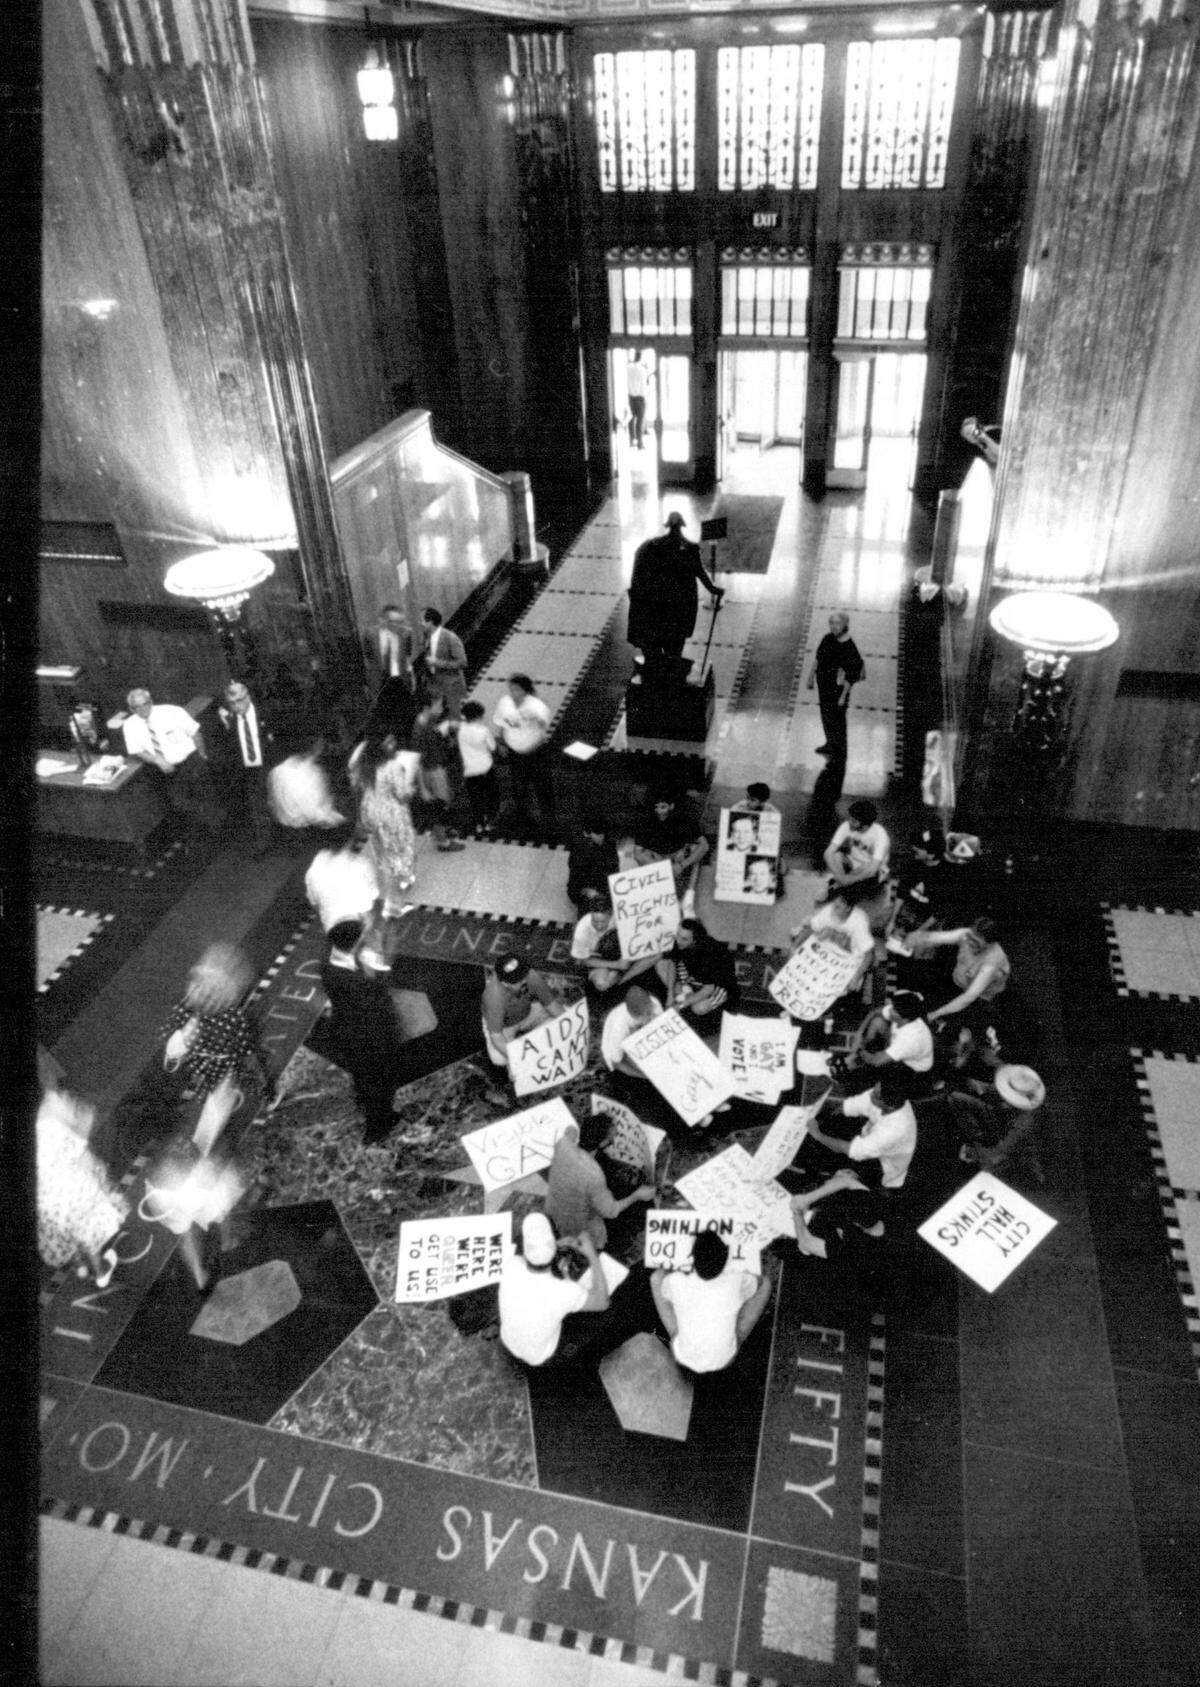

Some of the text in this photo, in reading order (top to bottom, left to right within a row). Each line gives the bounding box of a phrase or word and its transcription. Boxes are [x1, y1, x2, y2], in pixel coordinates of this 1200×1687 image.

[753, 213, 777, 227] EXIT
[613, 872, 669, 895] CIVIL
[617, 893, 677, 920] RIGHTS
[635, 912, 663, 933] FOR
[628, 931, 677, 957] GAYS
[521, 1001, 585, 1061] AIDS
[628, 1015, 688, 1059] VISIBLE
[531, 1047, 585, 1084] WAIT
[760, 1042, 775, 1074] GAY
[775, 1052, 786, 1068] AM
[649, 1218, 733, 1236] NOTHING
[937, 1190, 995, 1247] STINKS
[976, 1205, 1015, 1241] HALL
[409, 1238, 423, 1259] TO
[472, 1236, 486, 1276] HERE
[488, 1232, 503, 1278] WERE
[650, 1241, 676, 1259] DO
[996, 1220, 1030, 1258] CITY
[425, 1234, 440, 1294] GET USE
[455, 1237, 470, 1283] WERE
[784, 1322, 845, 1518] FIFTY
[221, 1457, 384, 1537] CITY
[436, 1505, 709, 1621] KANSAS
